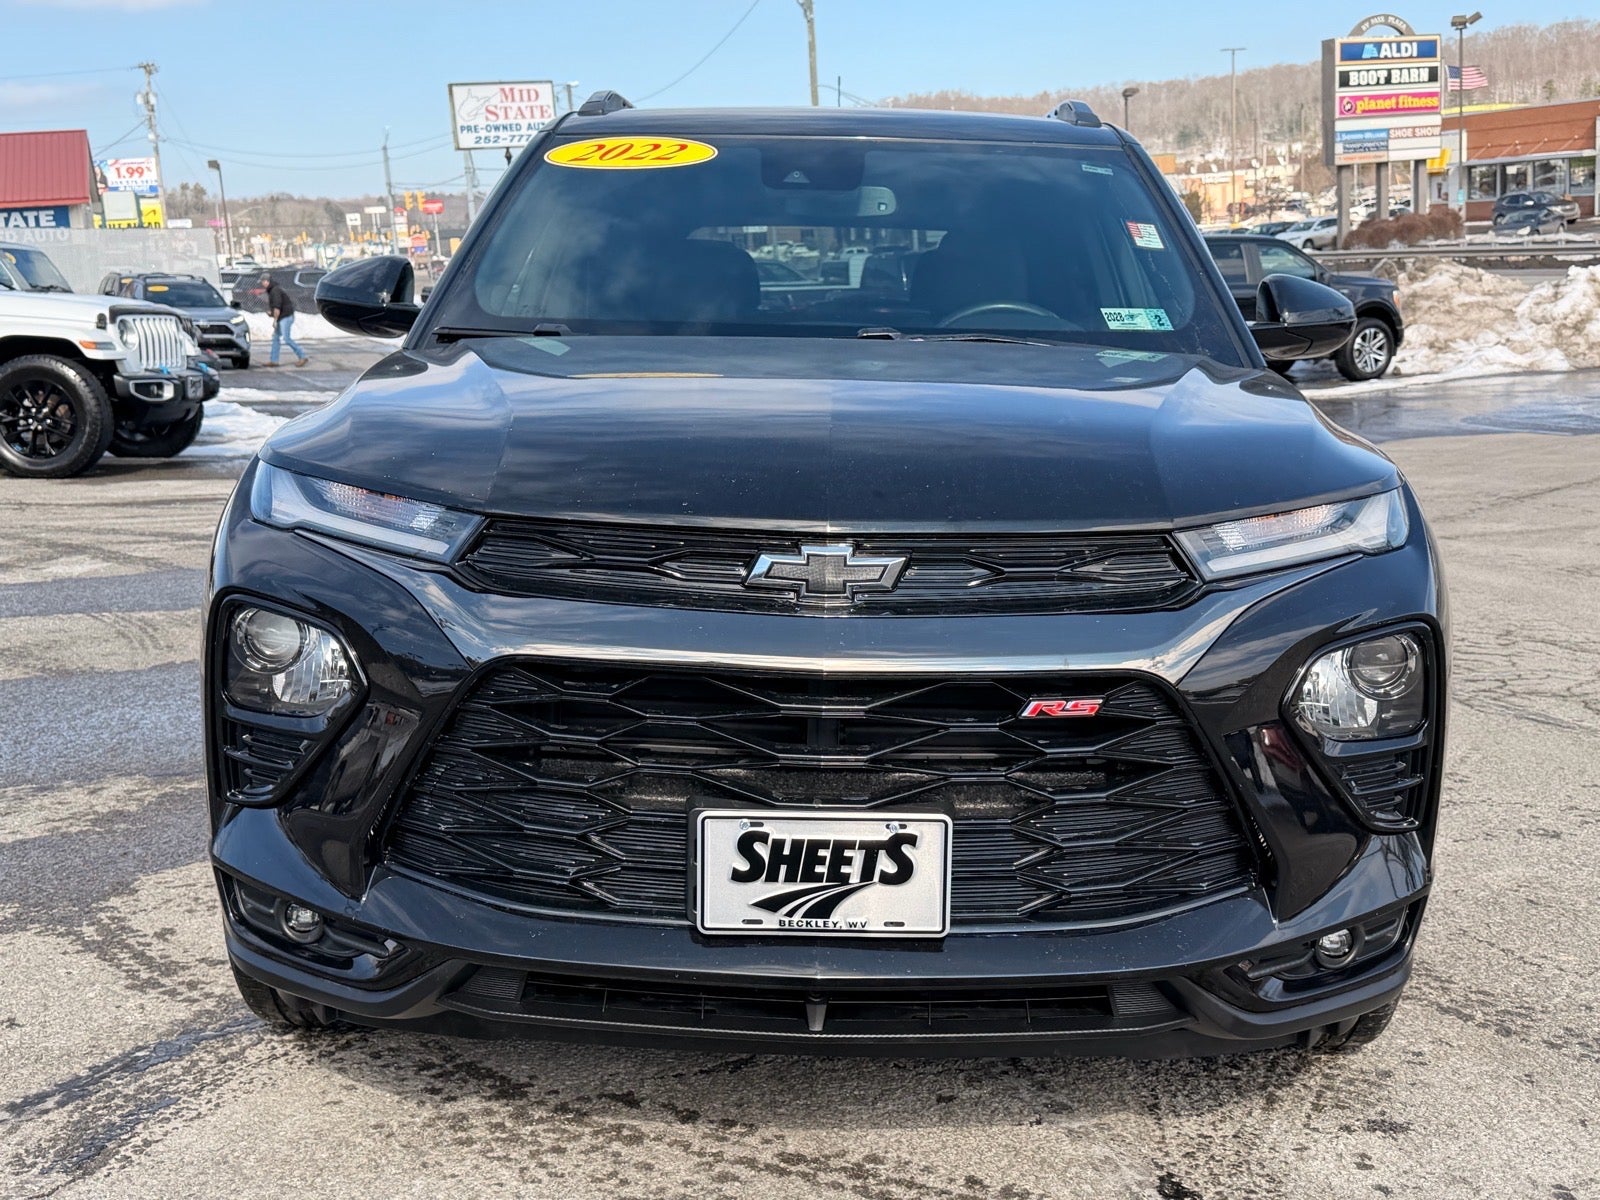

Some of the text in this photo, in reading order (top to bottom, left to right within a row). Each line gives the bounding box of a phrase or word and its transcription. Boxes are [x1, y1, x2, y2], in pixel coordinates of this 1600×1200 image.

[1379, 42, 1418, 58] ALDI
[1349, 68, 1429, 86] BOOT BARN
[499, 87, 540, 103] MID
[1356, 95, 1438, 113] planet fitness
[484, 104, 552, 122] STATE
[460, 123, 522, 134] PRE-OWNED
[1389, 128, 1413, 138] SHOE
[1414, 127, 1441, 137] SHOW
[568, 143, 688, 161] 2022
[24, 228, 69, 242] AUTO
[1154, 315, 1165, 326] 2
[1021, 699, 1103, 717] RS
[730, 830, 918, 885] SHEETS
[778, 919, 868, 930] BECKLEY, WV
